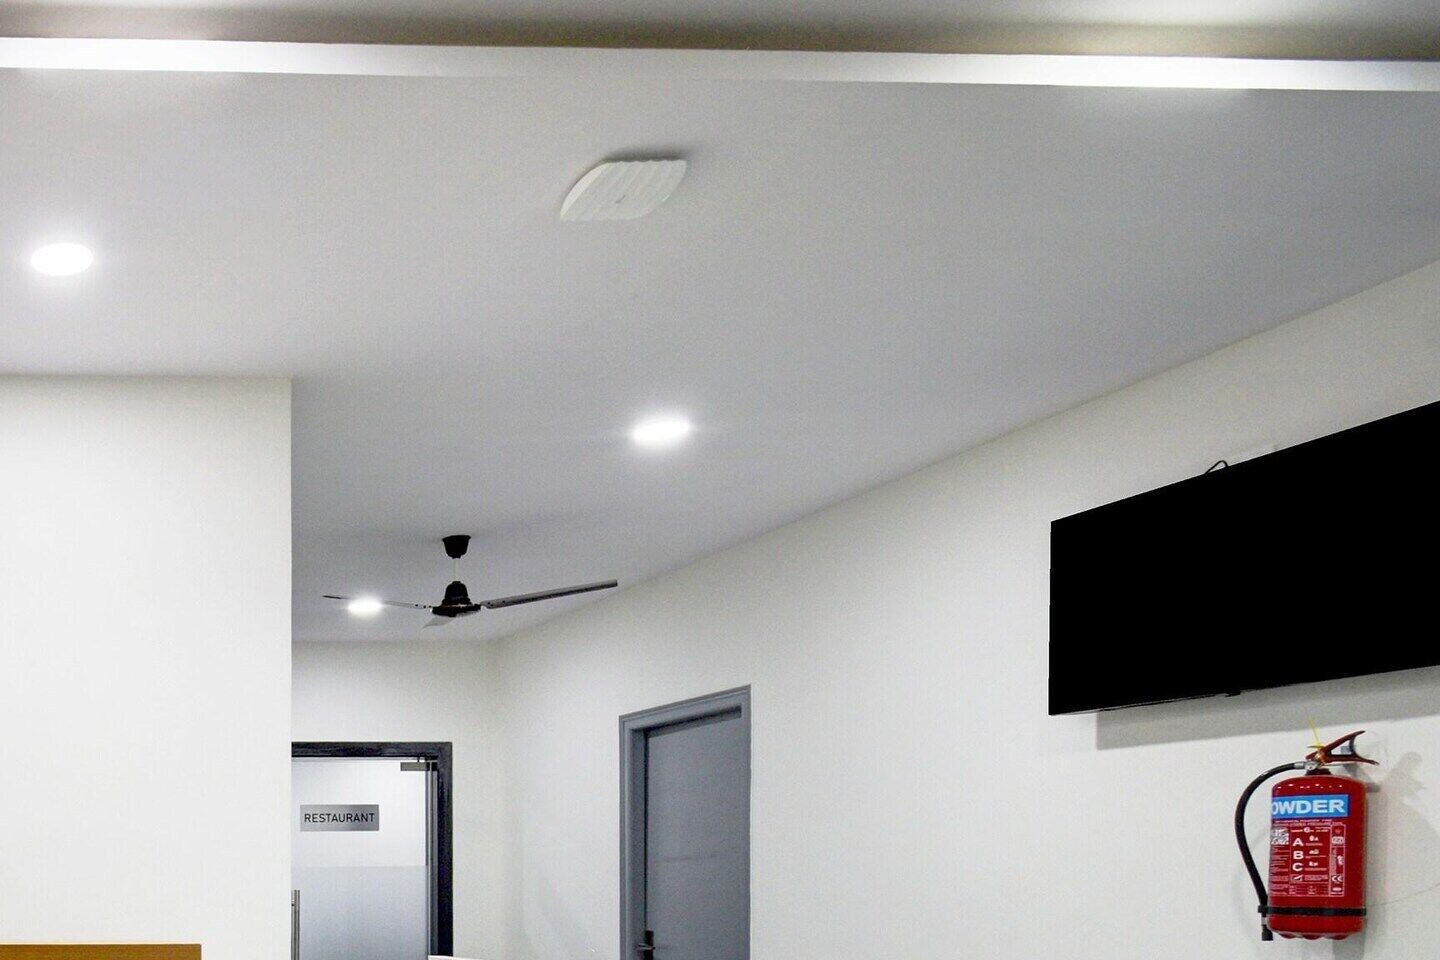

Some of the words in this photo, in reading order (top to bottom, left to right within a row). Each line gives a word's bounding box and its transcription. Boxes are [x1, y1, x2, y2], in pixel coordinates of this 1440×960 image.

[304, 812, 375, 823] RESTAURANT
[1293, 838, 1304, 846] A
[1293, 851, 1304, 859] B
[1292, 863, 1303, 871] C
